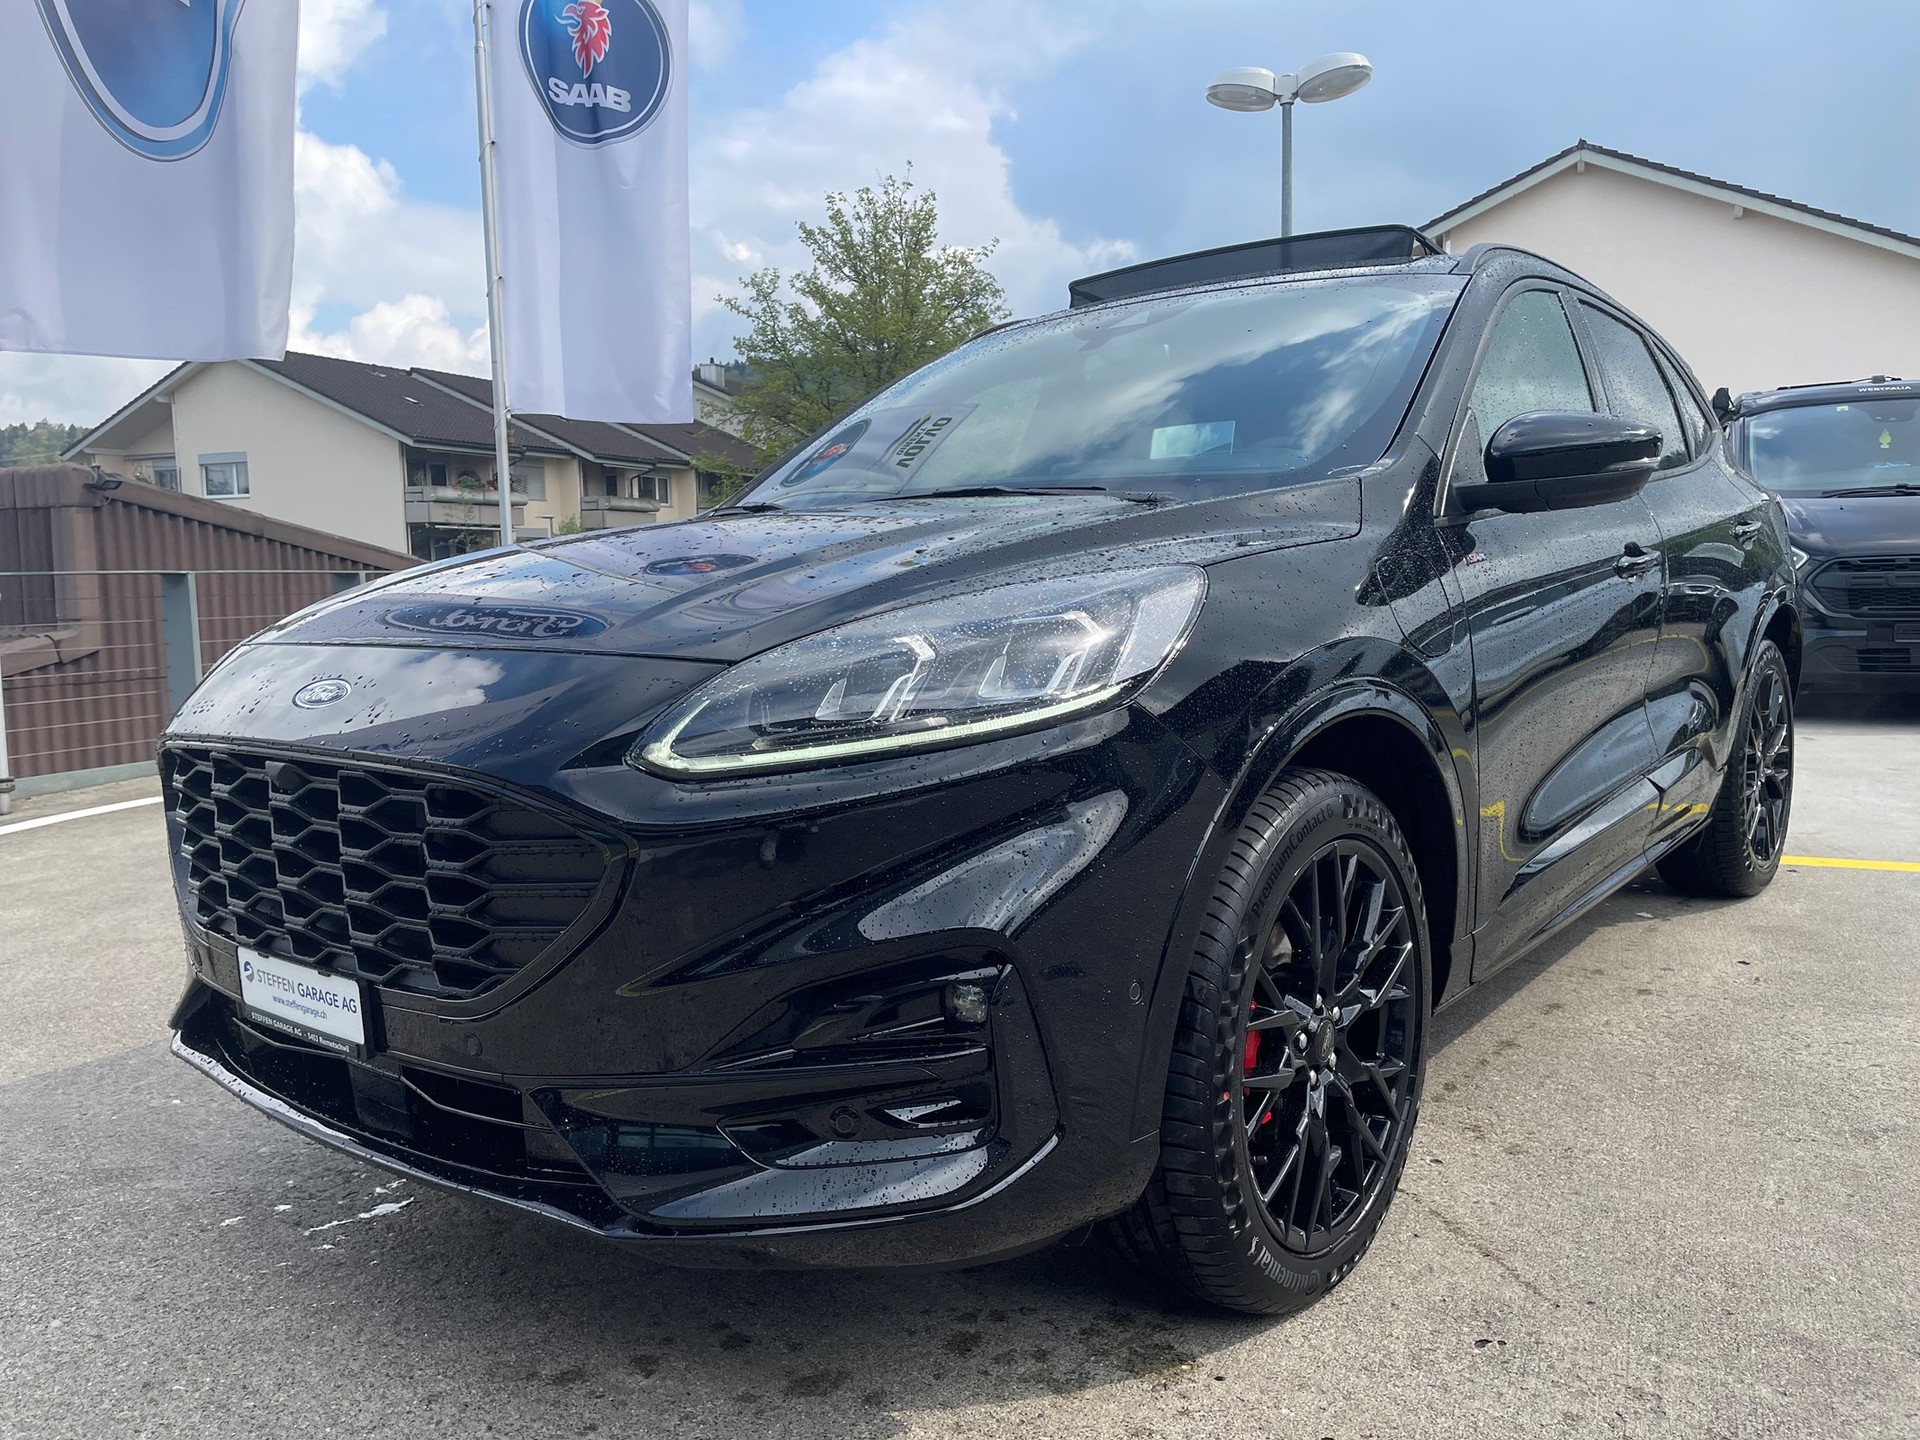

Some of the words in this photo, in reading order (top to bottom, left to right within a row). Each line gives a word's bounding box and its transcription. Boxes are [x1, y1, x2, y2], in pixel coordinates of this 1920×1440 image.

[548, 77, 631, 113] SAAB
[1251, 807, 1326, 919] PremiumContact
[1325, 803, 1334, 818] 6
[257, 969, 295, 994] STEFFEN
[297, 983, 339, 1008] GARAGE
[341, 997, 357, 1014] AG
[272, 994, 328, 1020] www.steffengarage.ch
[251, 1012, 273, 1025] STEFFEN
[273, 1020, 294, 1034] GARAGE
[294, 1028, 302, 1036] AG
[1253, 1245, 1320, 1296] Continental
